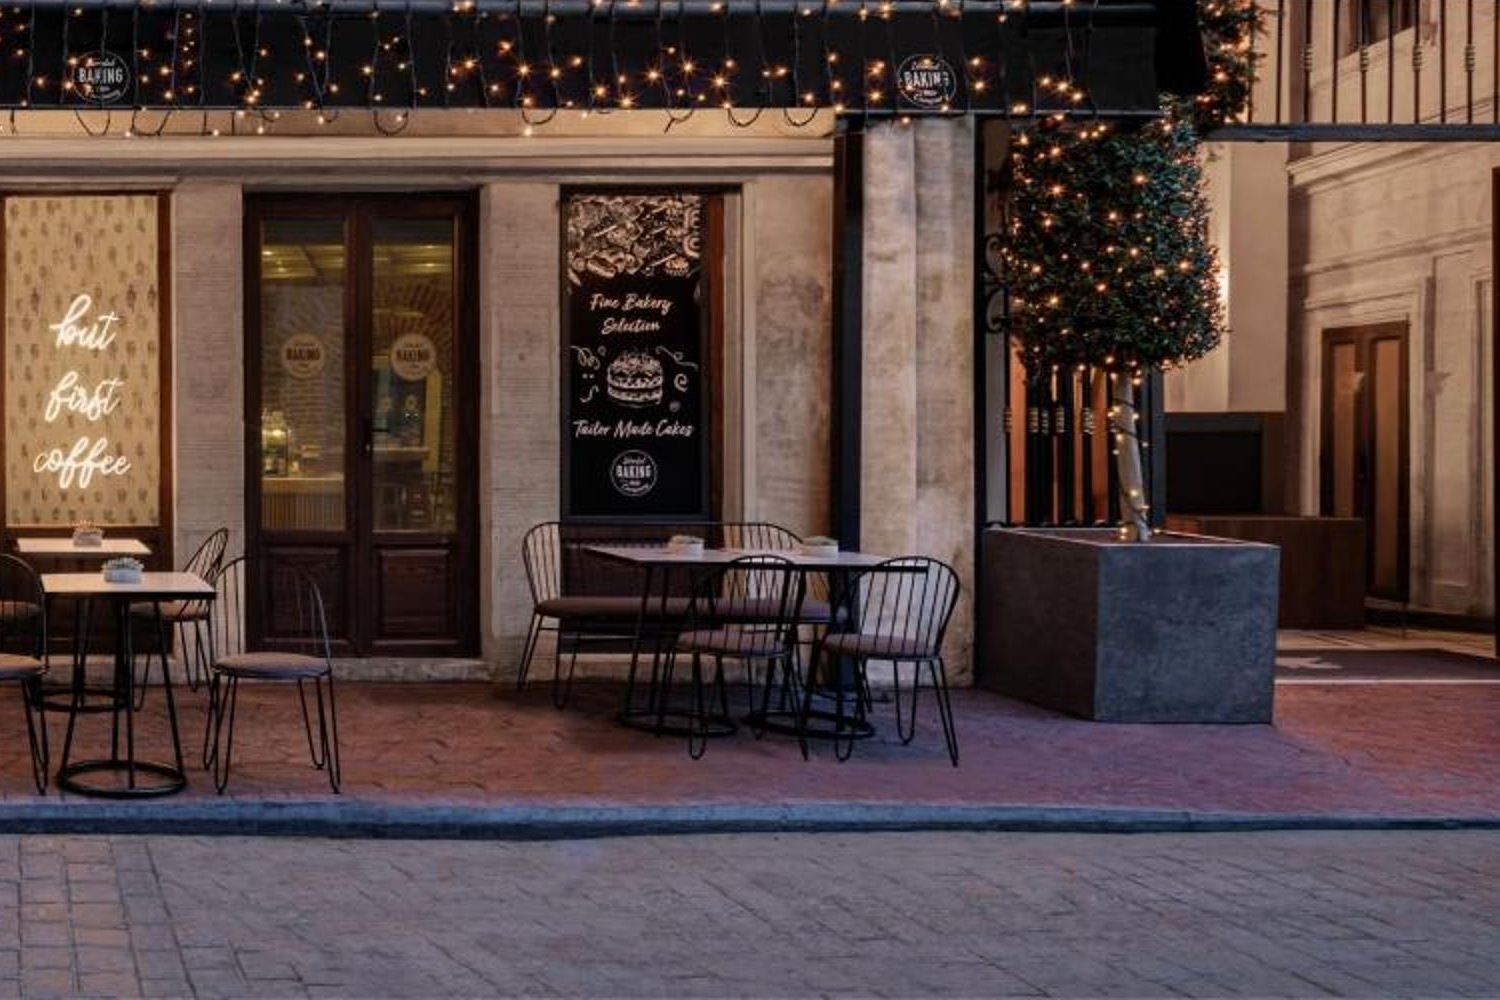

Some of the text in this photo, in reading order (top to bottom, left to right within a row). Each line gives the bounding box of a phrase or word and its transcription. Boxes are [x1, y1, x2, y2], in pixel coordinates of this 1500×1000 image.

[49, 294, 119, 350] but
[589, 293, 673, 315] Fine Bakery
[601, 317, 660, 335] Selection
[45, 371, 124, 421] first
[572, 419, 694, 438] Tailor Made Cakes
[34, 437, 130, 488] coffee
